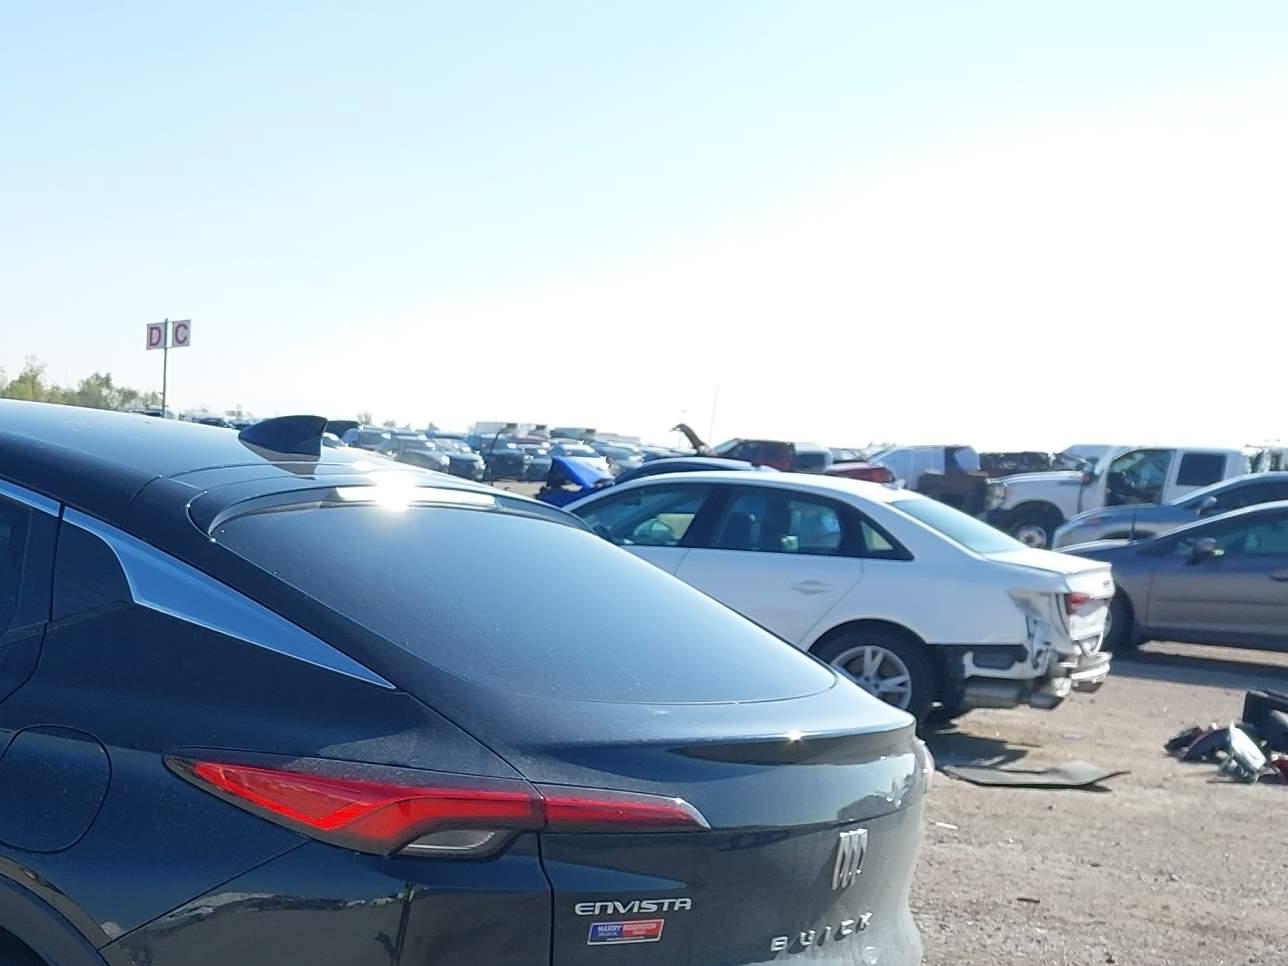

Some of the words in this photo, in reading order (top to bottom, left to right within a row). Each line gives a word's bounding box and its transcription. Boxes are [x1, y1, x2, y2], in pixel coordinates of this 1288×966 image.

[149, 326, 162, 346] D
[175, 323, 188, 344] C
[574, 897, 693, 916] ENVISTA
[770, 911, 873, 952] BUICK
